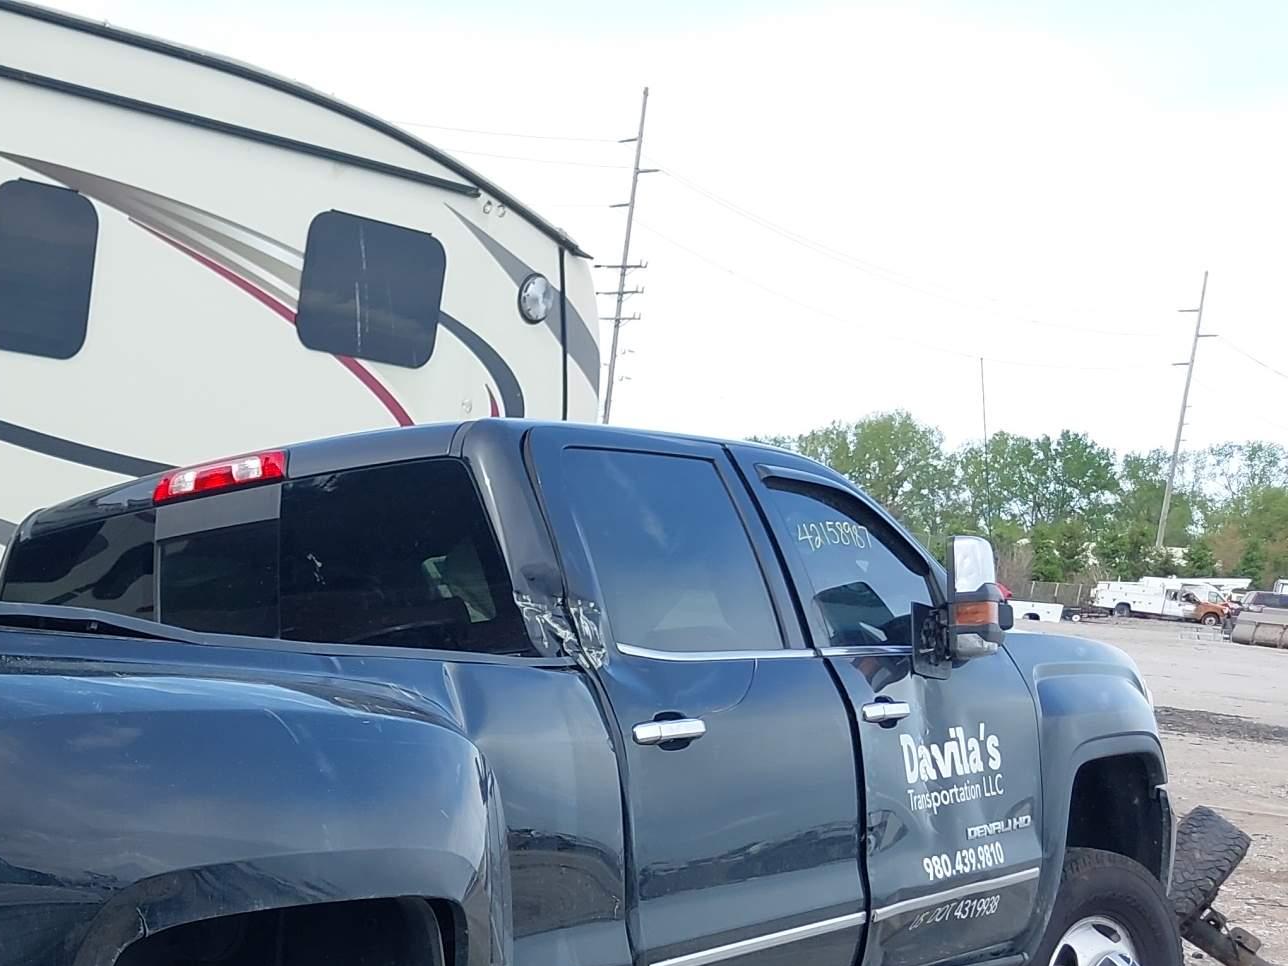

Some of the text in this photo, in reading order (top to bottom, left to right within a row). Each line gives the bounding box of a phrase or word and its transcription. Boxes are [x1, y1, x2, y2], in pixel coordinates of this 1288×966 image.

[796, 521, 872, 552] 42158987
[899, 723, 1001, 784] Davila's
[907, 774, 1004, 815] Transportation LLC
[966, 815, 1032, 840] DENALI HD
[923, 841, 1005, 880] 980.439.9810
[926, 902, 957, 924] DOT
